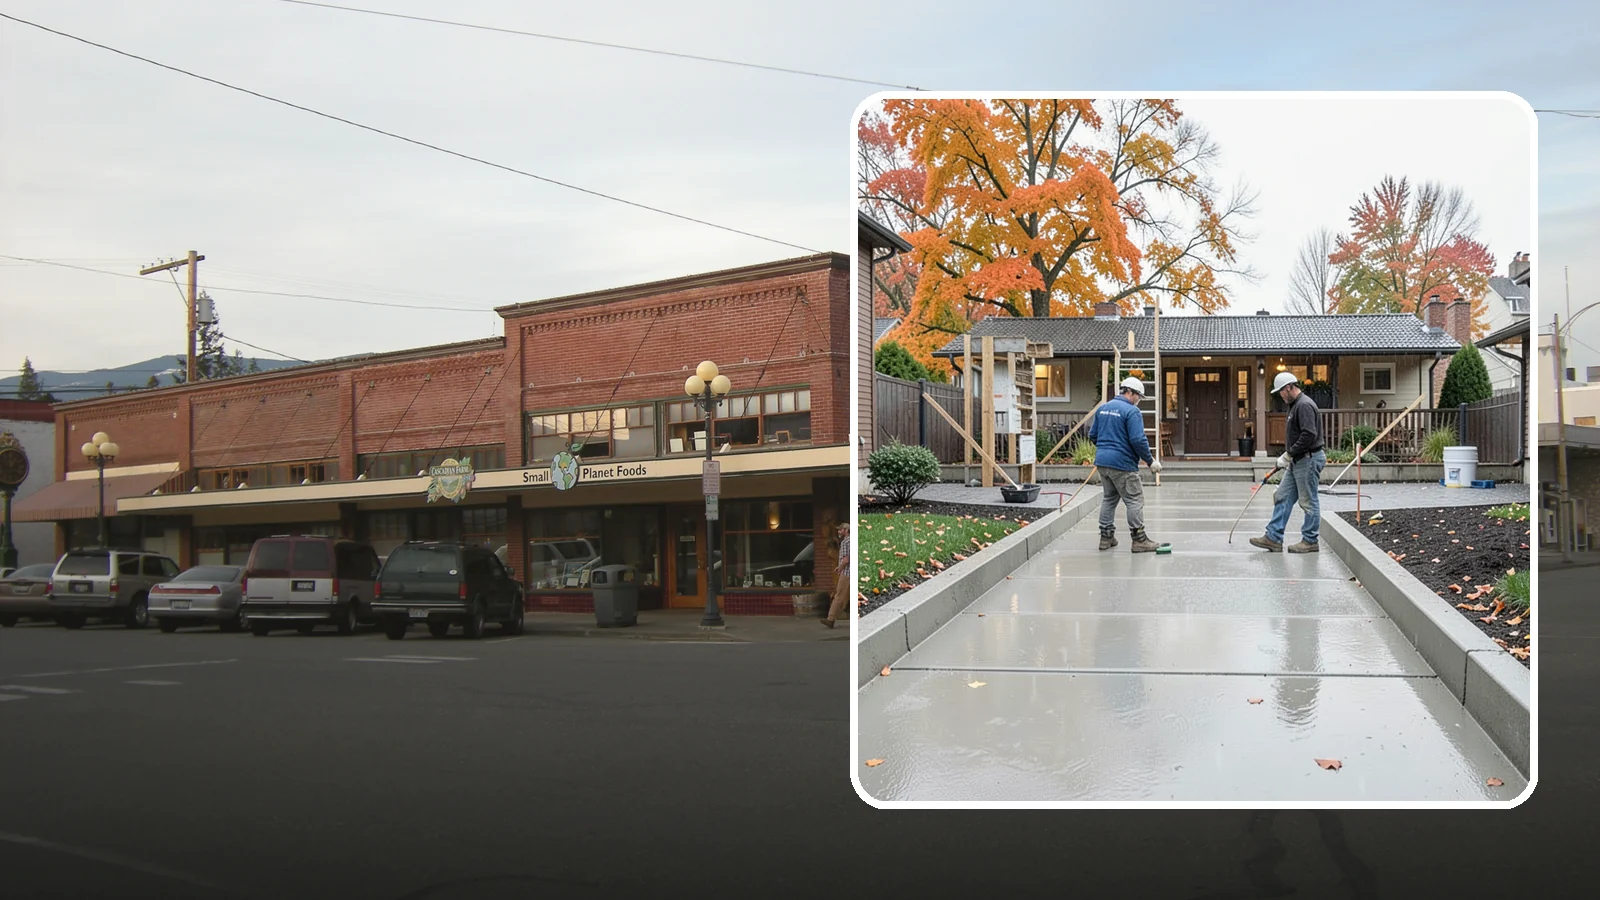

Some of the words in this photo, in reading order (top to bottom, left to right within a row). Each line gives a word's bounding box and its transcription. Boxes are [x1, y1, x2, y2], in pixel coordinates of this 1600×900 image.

[523, 471, 549, 483] Small
[583, 467, 614, 479] Planet
[617, 464, 646, 477] Foods
